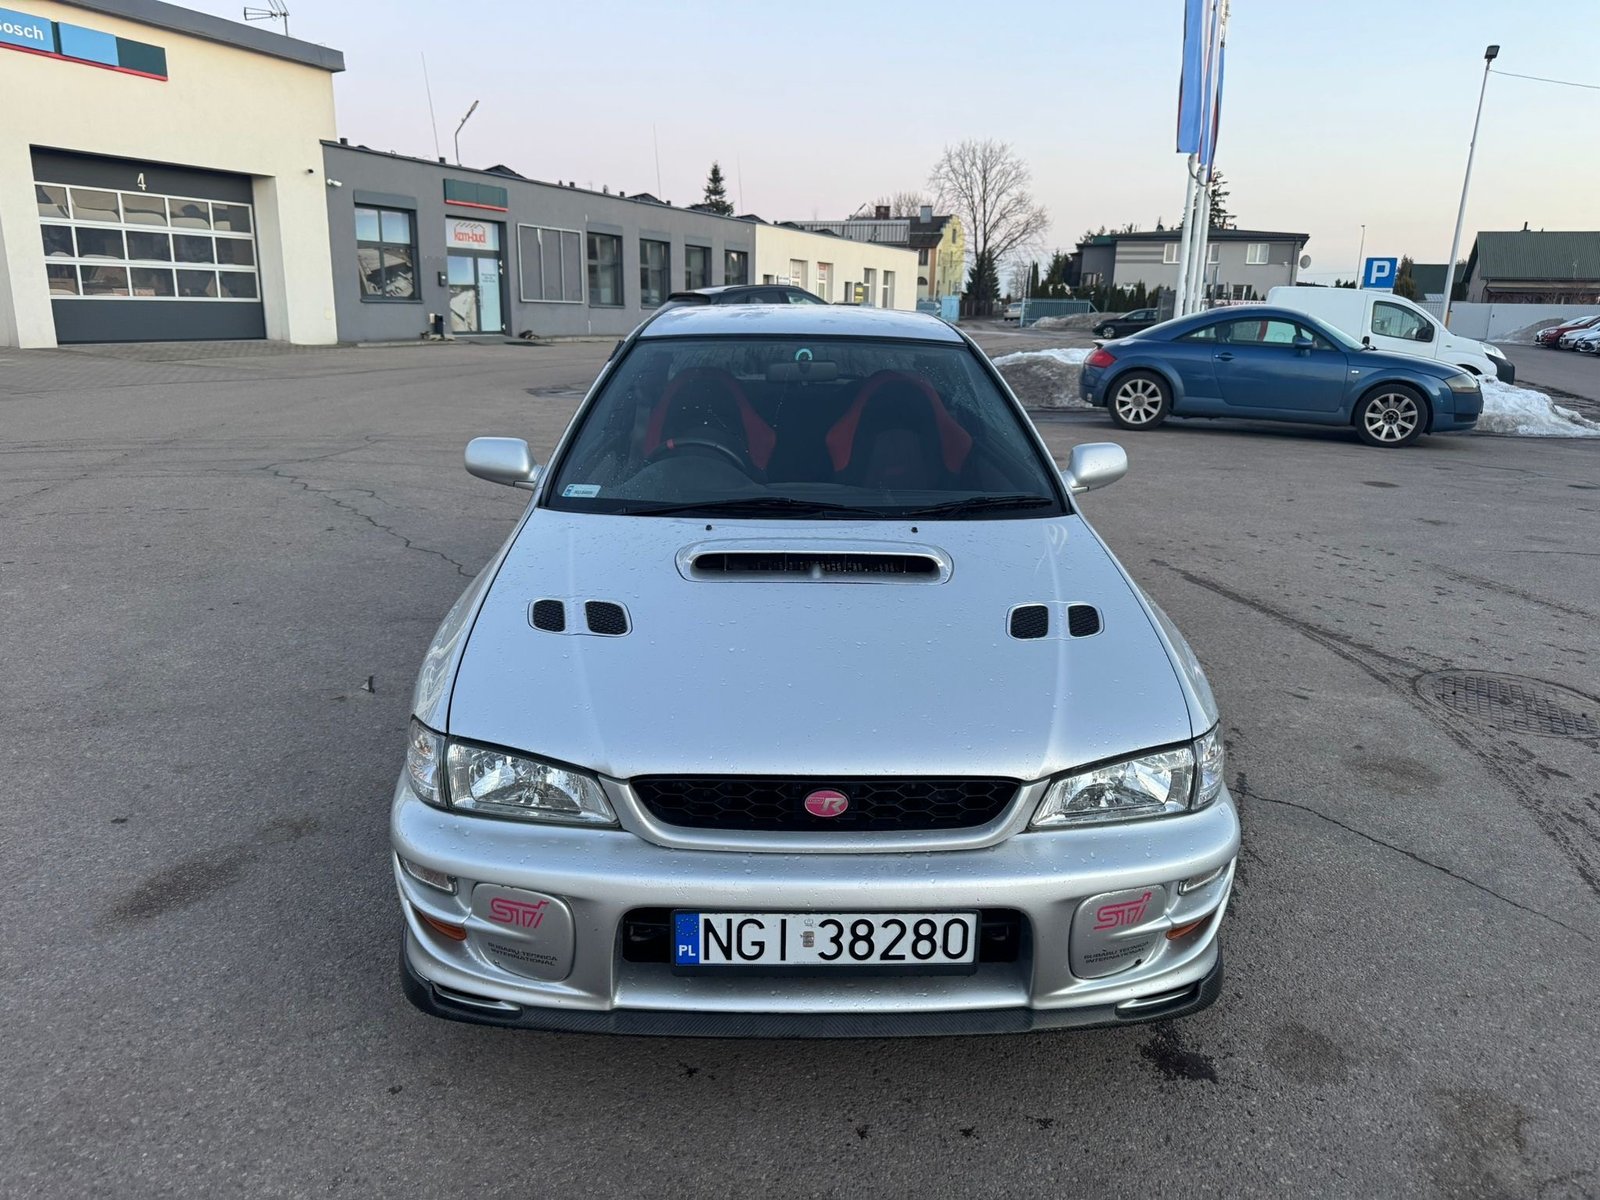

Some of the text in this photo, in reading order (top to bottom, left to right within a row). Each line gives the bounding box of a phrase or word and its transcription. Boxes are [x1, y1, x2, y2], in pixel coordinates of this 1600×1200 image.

[0, 22, 44, 41] osch
[137, 172, 147, 191] 4
[1370, 260, 1390, 284] P
[703, 918, 970, 961] NGI 38280
[678, 944, 696, 957] PL
